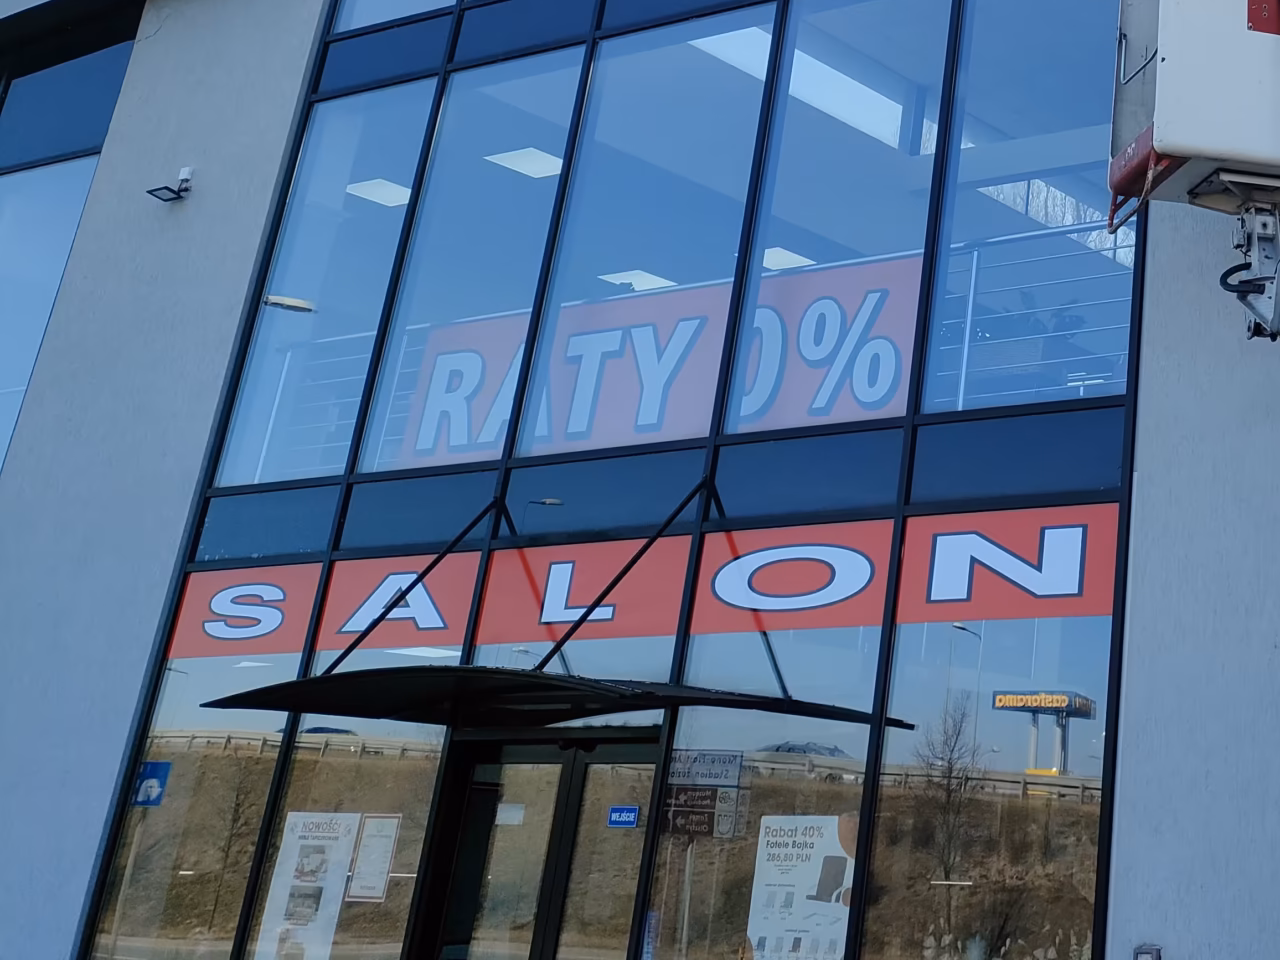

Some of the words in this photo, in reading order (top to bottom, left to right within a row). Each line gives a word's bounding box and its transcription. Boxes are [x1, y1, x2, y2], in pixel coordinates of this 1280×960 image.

[412, 314, 709, 456] RATY
[202, 523, 1089, 641] SALON
[611, 810, 635, 822] WEJŚCIE
[301, 819, 341, 832] NOWOŚĆ!
[764, 825, 798, 839] Rabat
[801, 825, 824, 839] 40%
[766, 840, 789, 850] Fotele
[791, 840, 815, 851] Bajka
[766, 852, 794, 864] 286,80
[795, 853, 812, 863] PLN
